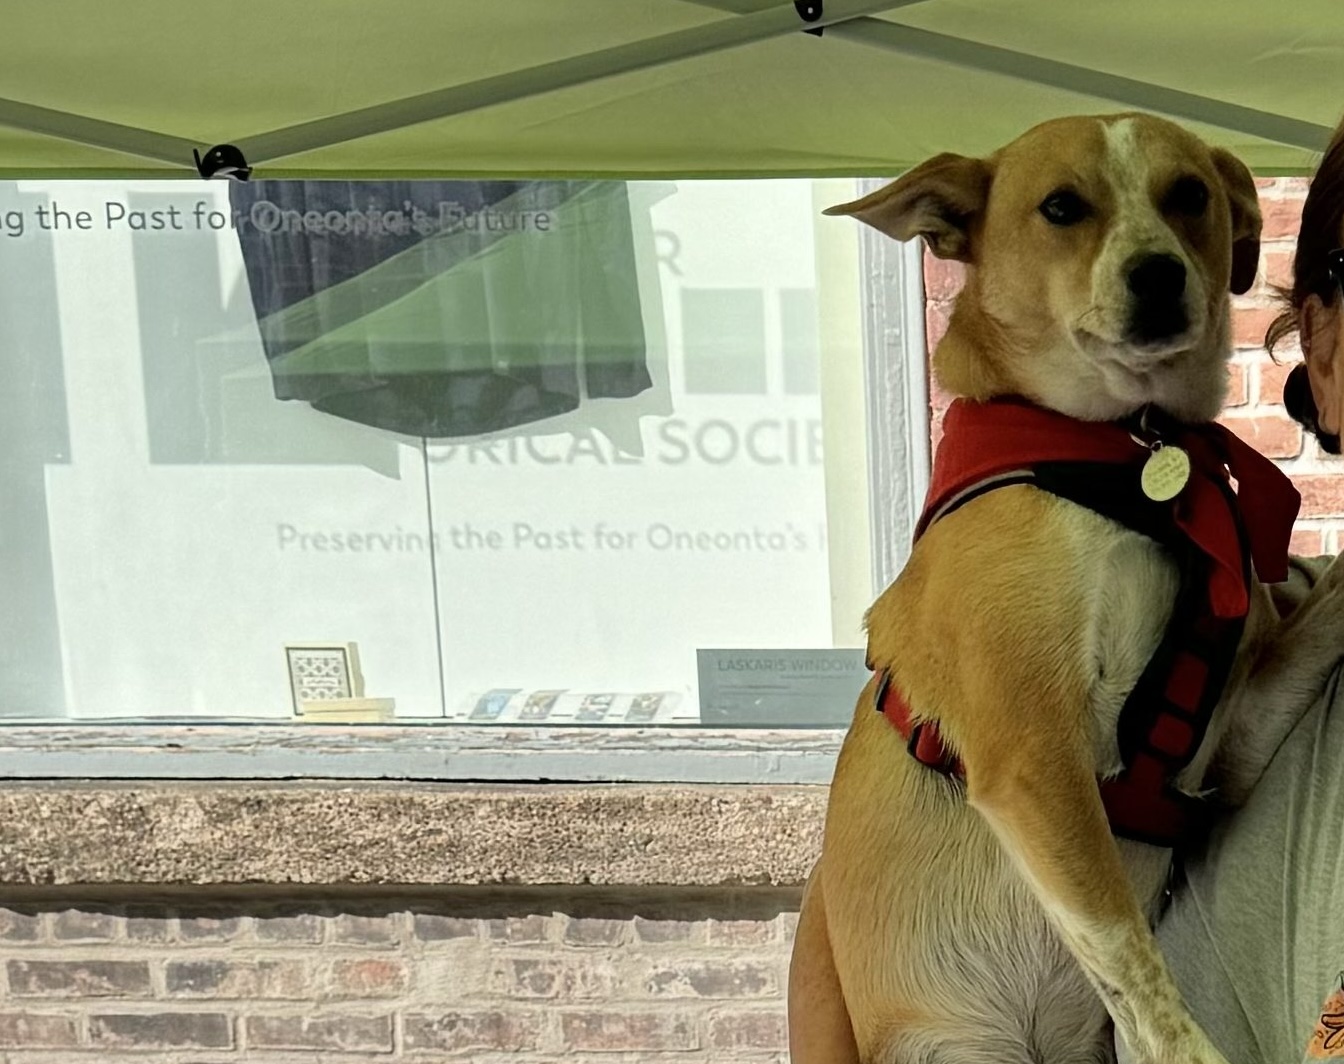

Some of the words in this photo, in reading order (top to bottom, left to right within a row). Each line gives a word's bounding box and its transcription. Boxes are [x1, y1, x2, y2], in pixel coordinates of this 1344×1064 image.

[36, 201, 92, 230] the
[106, 201, 183, 230] Past
[193, 201, 246, 230] for
[251, 200, 428, 233] Oneonta's
[440, 201, 551, 232] Future
[451, 523, 502, 550] the
[513, 523, 585, 550] Past
[595, 522, 638, 550] for
[646, 521, 807, 550] Oneonta's
